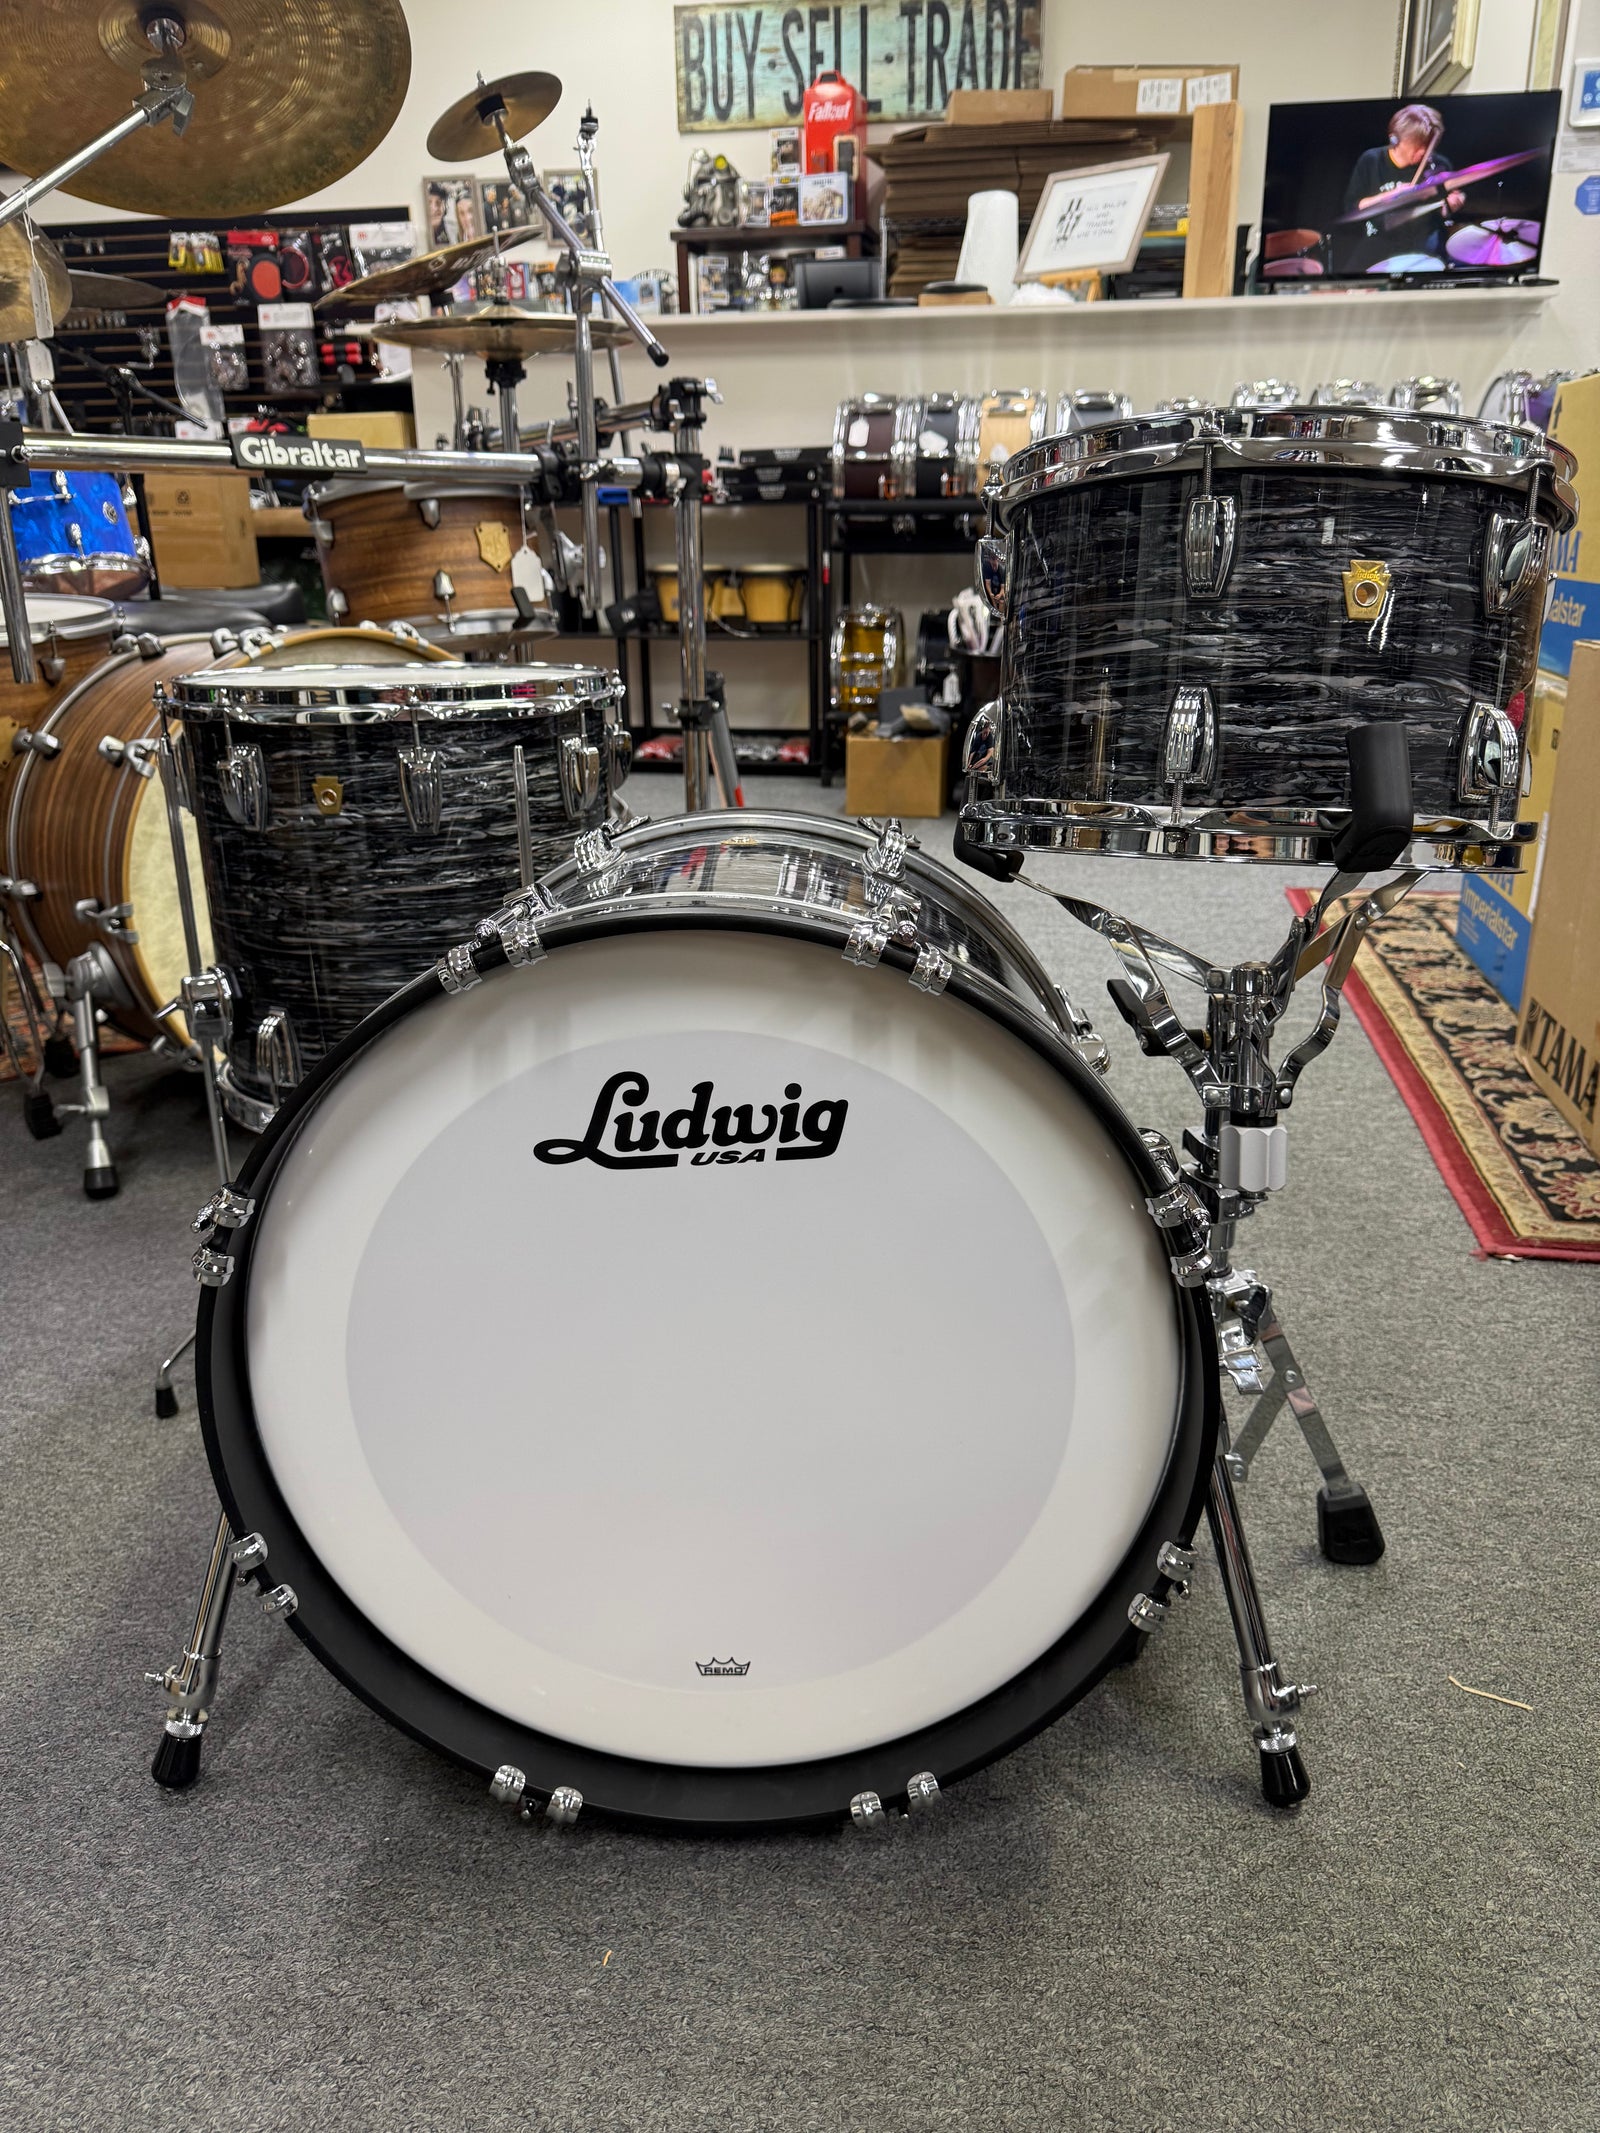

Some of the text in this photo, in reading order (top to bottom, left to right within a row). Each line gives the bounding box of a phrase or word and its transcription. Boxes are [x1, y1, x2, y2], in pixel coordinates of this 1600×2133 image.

[683, 0, 1042, 122] BUY SELL TRADE
[808, 100, 851, 122] Fallout
[240, 437, 360, 468] Gibraltar
[1462, 879, 1518, 950] Imperialstar
[1533, 1008, 1600, 1124] TAMA
[533, 1071, 848, 1170] Ludwig
[690, 1149, 765, 1166] USA
[704, 1666, 743, 1674] REMO
